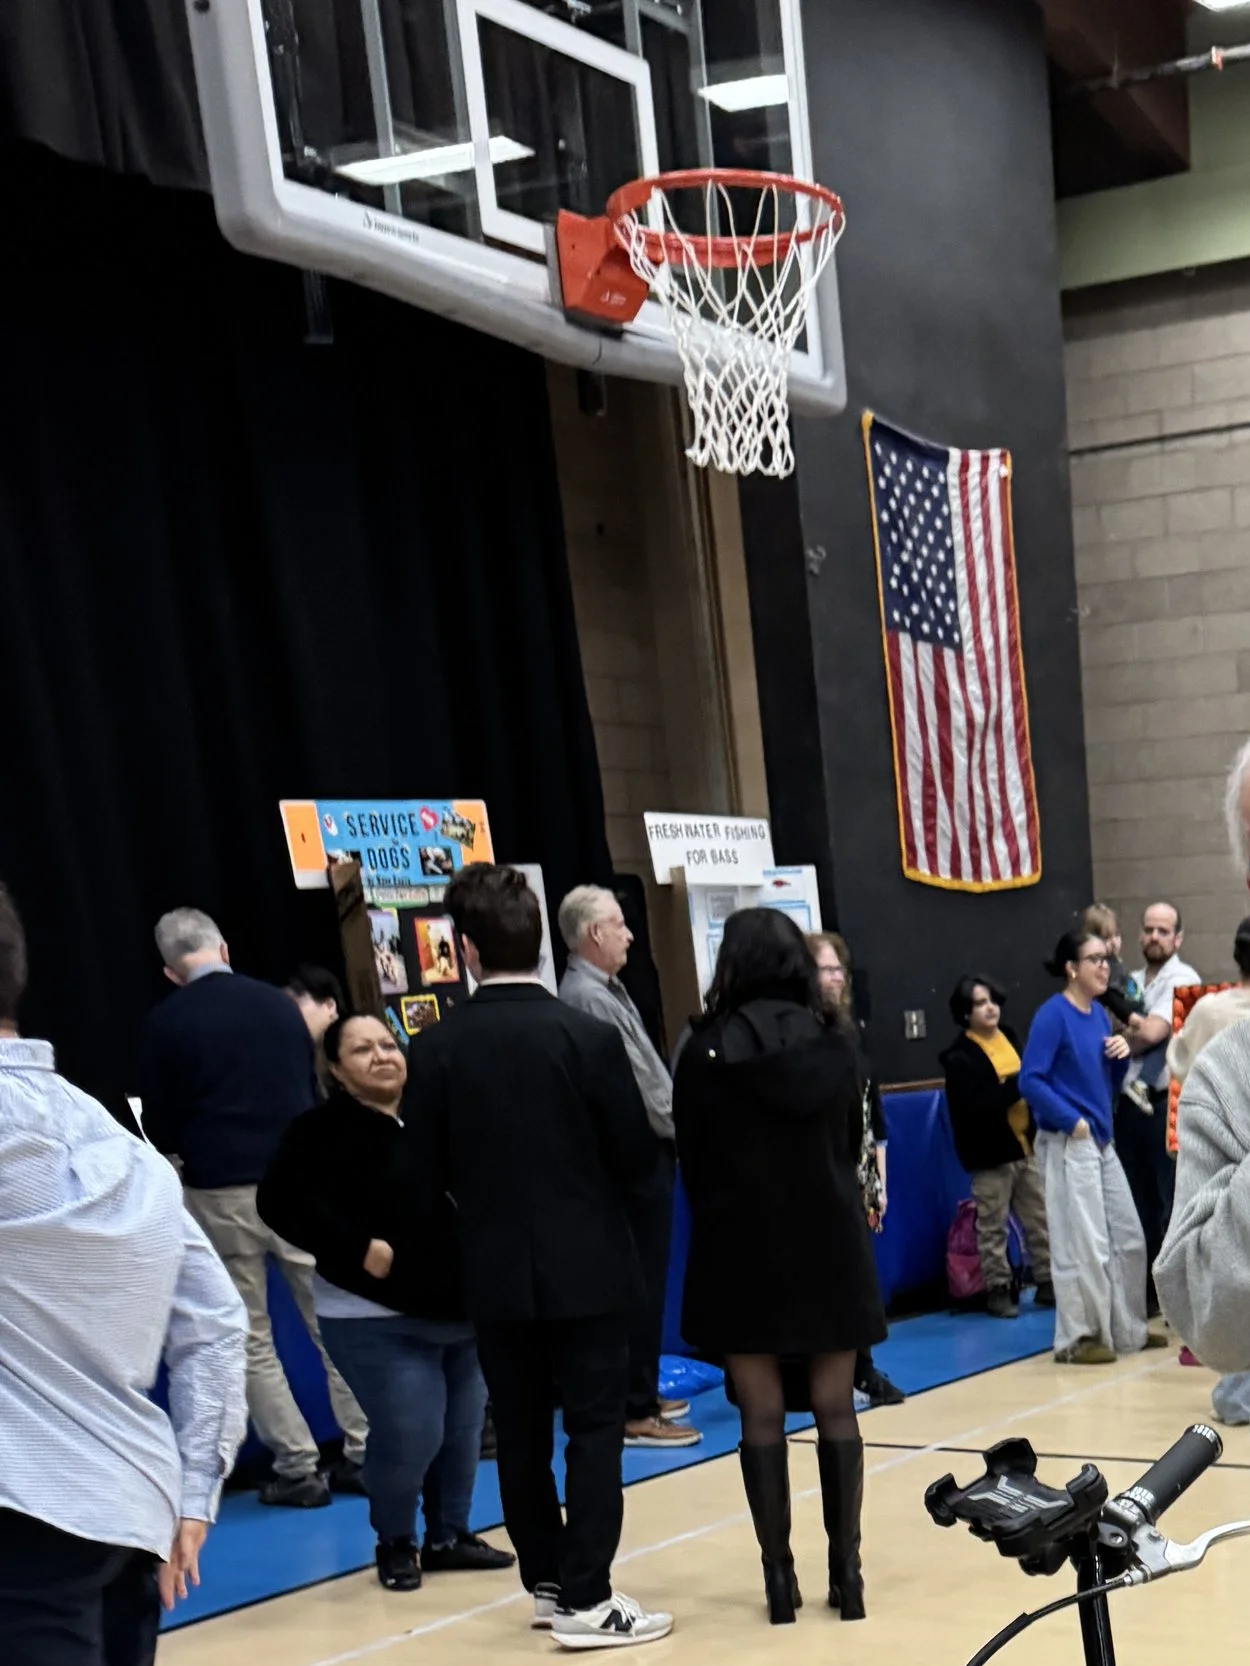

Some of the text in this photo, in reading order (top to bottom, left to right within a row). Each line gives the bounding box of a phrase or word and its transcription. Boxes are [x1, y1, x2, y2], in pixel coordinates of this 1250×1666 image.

[346, 812, 420, 838] SERVICE
[649, 823, 766, 841] FRESHWATER FISHING
[367, 846, 411, 870] DOGS
[686, 848, 739, 865] FOR BASS
